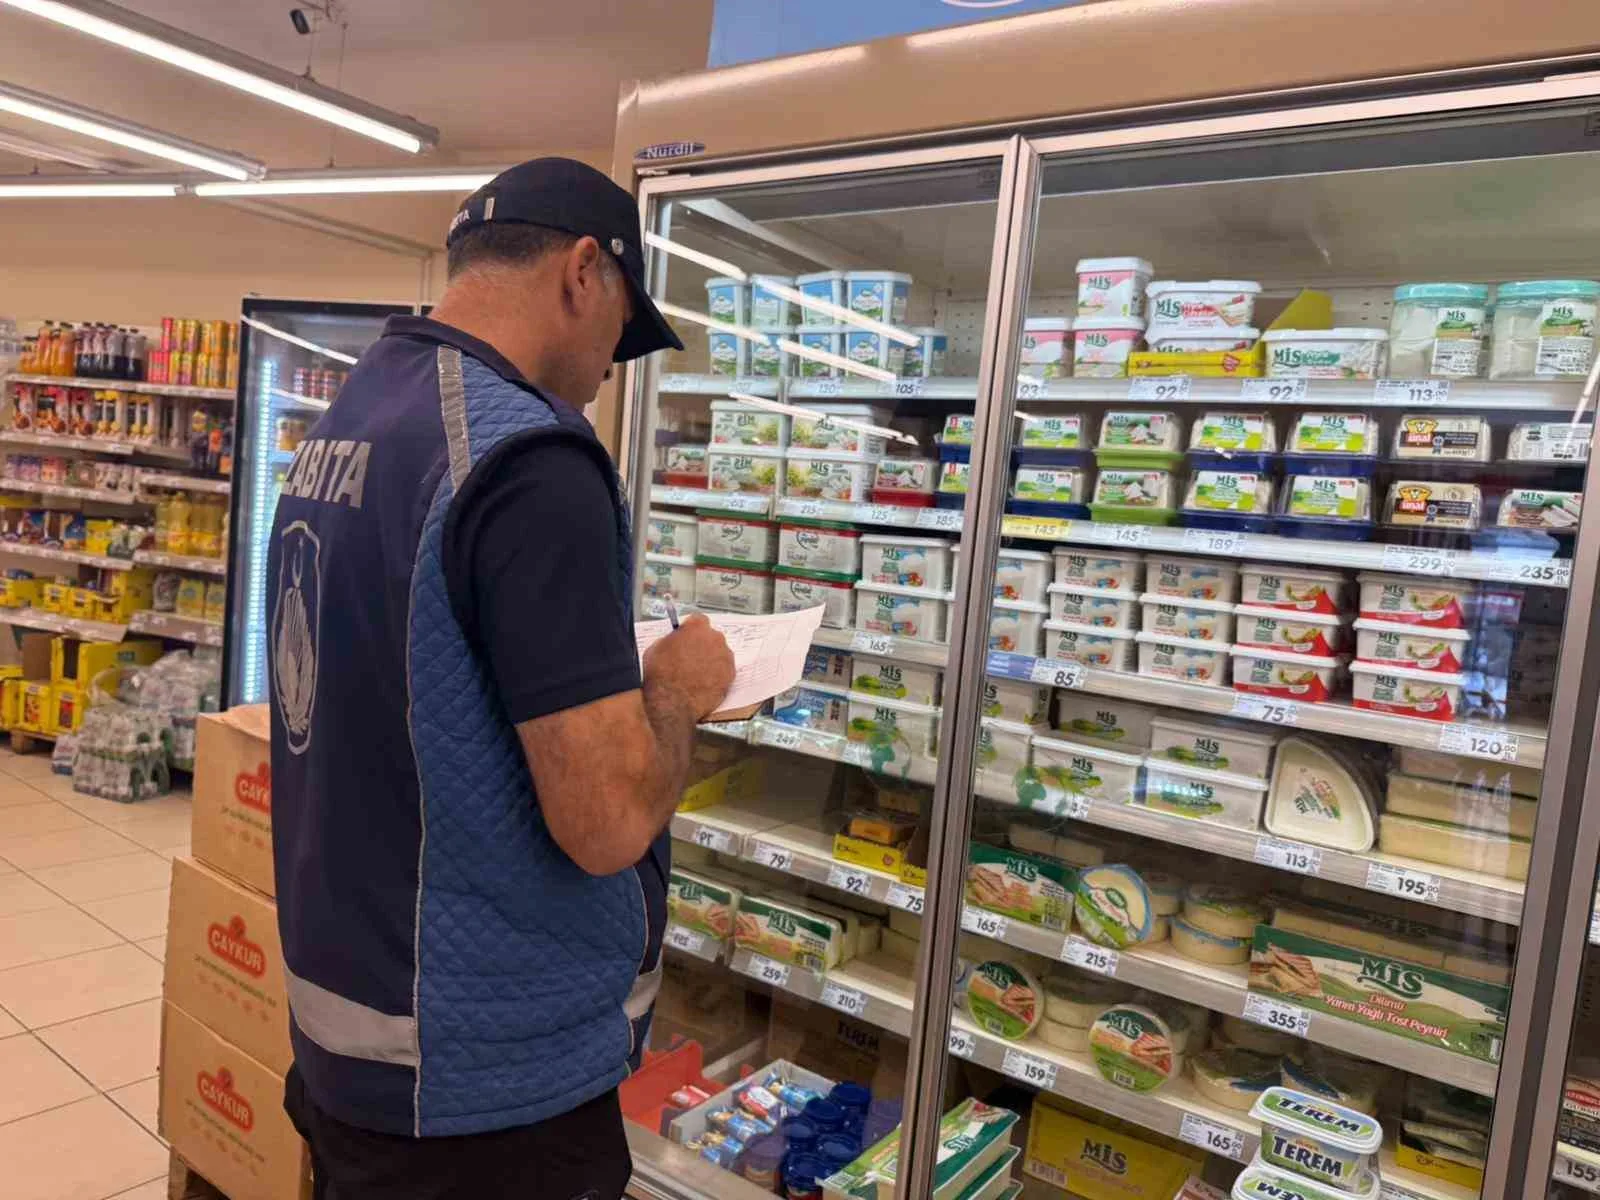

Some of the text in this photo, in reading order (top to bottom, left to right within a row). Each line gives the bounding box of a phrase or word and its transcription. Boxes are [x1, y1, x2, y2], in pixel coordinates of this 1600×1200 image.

[648, 143, 693, 158] Nurdil
[1156, 385, 1178, 401] 92
[1270, 386, 1293, 401] 92
[1409, 388, 1433, 401] 113
[1519, 564, 1554, 581] 235
[1053, 671, 1076, 687] 85
[1262, 704, 1287, 723] 75
[1470, 737, 1502, 756] 120
[771, 852, 786, 869] 79
[1285, 852, 1308, 868] 113
[846, 876, 864, 893] 92
[1398, 876, 1425, 895] 195
[906, 894, 923, 911] 75
[976, 917, 997, 934] 165
[1085, 952, 1107, 969] 215
[1359, 956, 1425, 996] MİS
[1268, 1010, 1296, 1029] 355
[1024, 1065, 1046, 1081] 159
[1278, 1098, 1361, 1132] TEREM
[1207, 1130, 1231, 1150] 165
[1083, 1138, 1127, 1171] MİS
[1272, 1135, 1343, 1177] TEREM
[1565, 1159, 1597, 1182] 155
